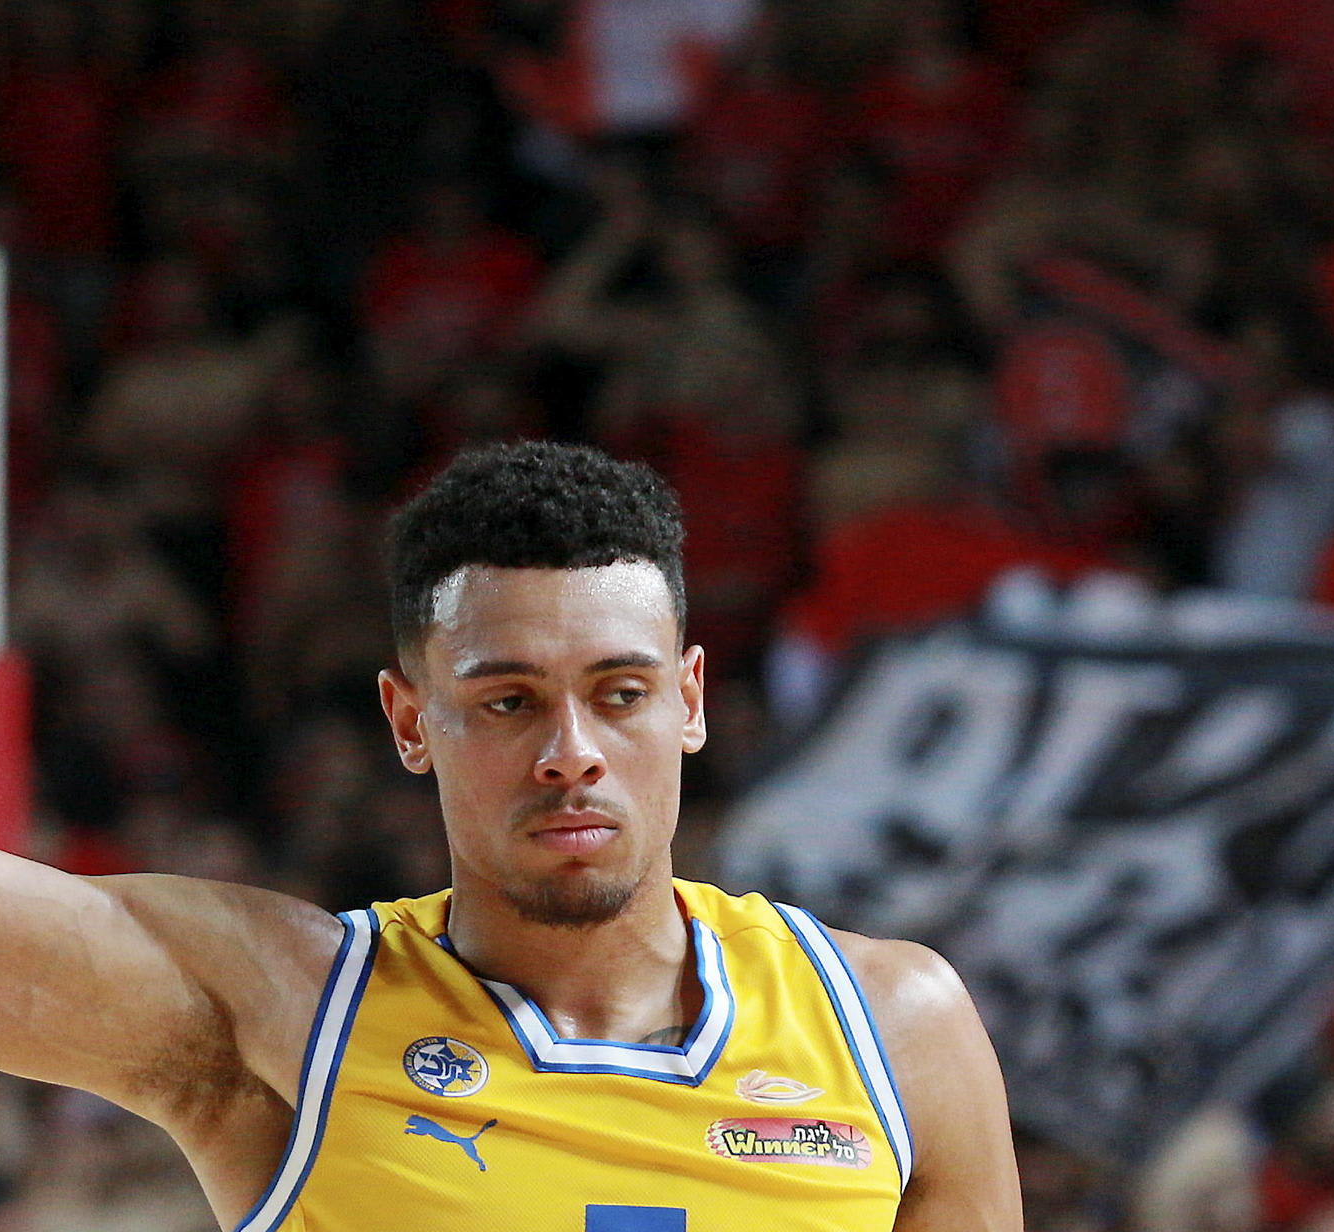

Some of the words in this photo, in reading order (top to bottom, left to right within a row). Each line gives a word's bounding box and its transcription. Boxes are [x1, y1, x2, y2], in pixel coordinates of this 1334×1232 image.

[723, 1129, 831, 1157] Winner
[832, 1141, 855, 1161] סל
[794, 1124, 829, 1143] ליגת
